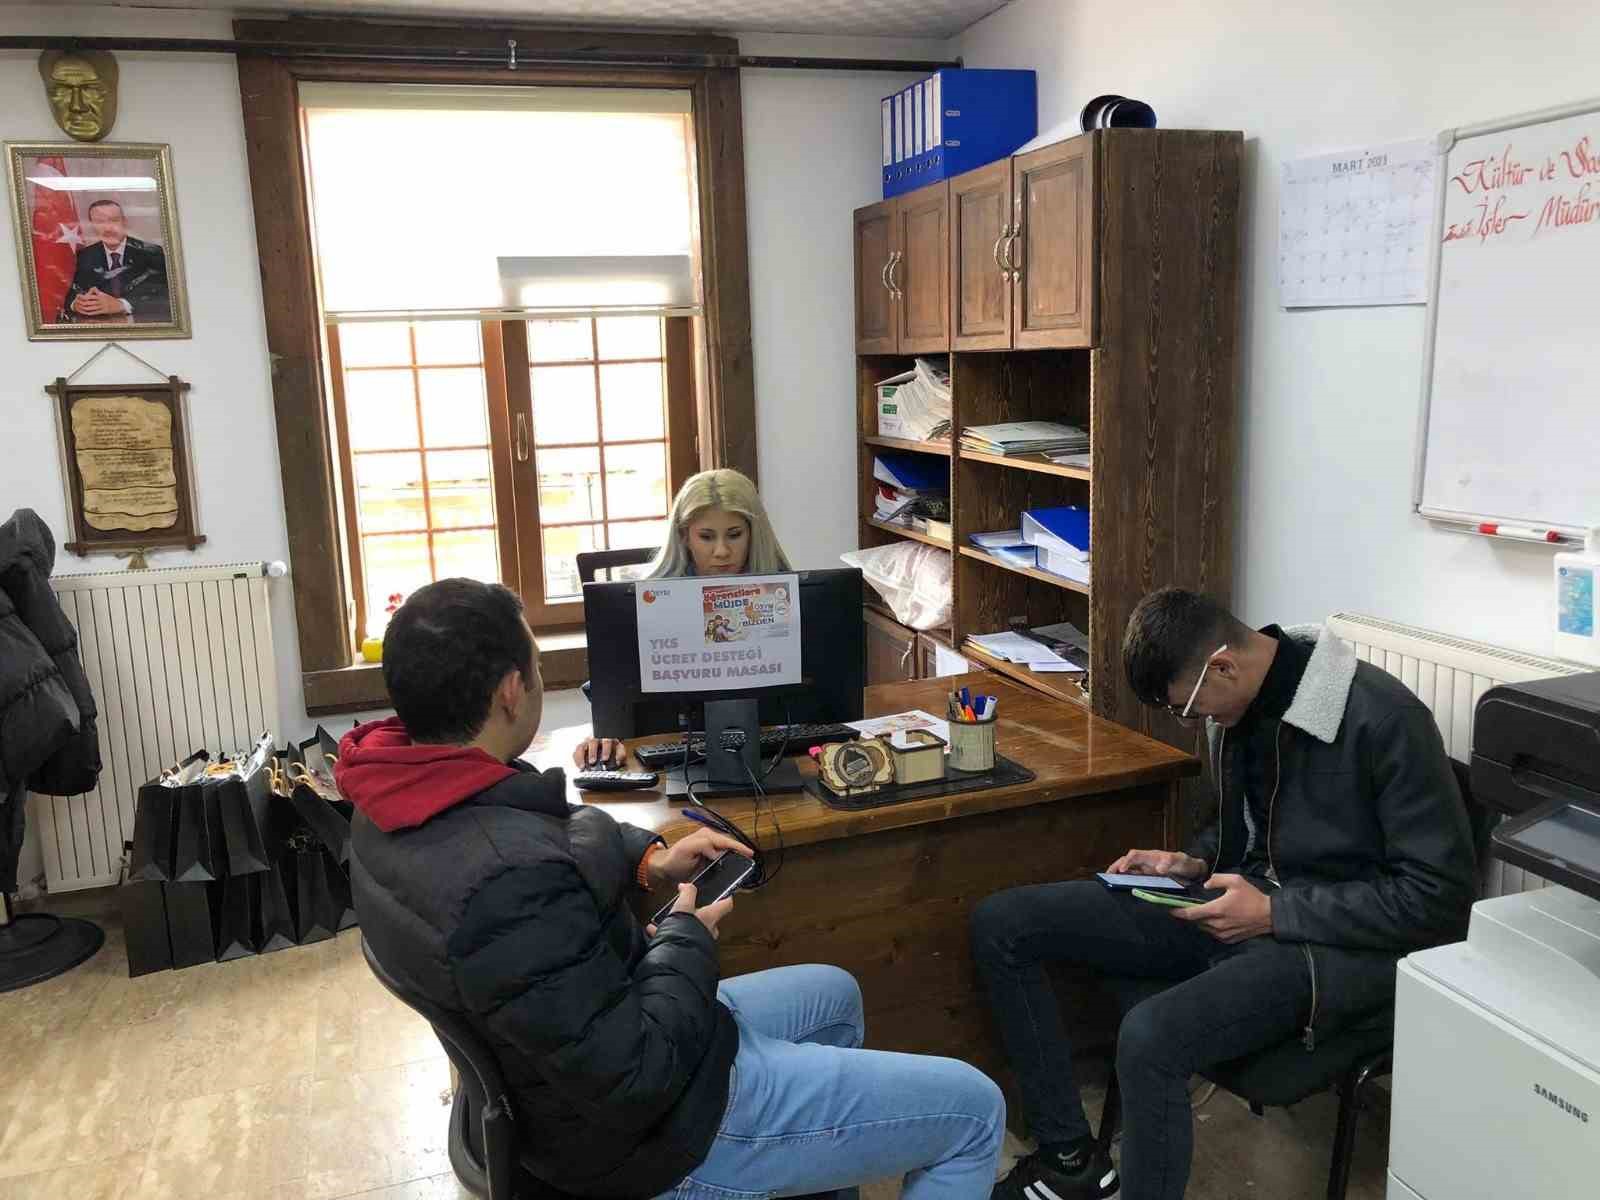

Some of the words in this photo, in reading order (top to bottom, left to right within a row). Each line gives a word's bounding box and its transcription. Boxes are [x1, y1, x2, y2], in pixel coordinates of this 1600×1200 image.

[1332, 159, 1363, 174] MART
[650, 637, 679, 649] YKS
[651, 650, 697, 665] ÜCRET
[652, 667, 722, 682] BAŞVURU
[726, 663, 782, 678] MASASI
[1533, 1083, 1588, 1122] SAMSUNG
